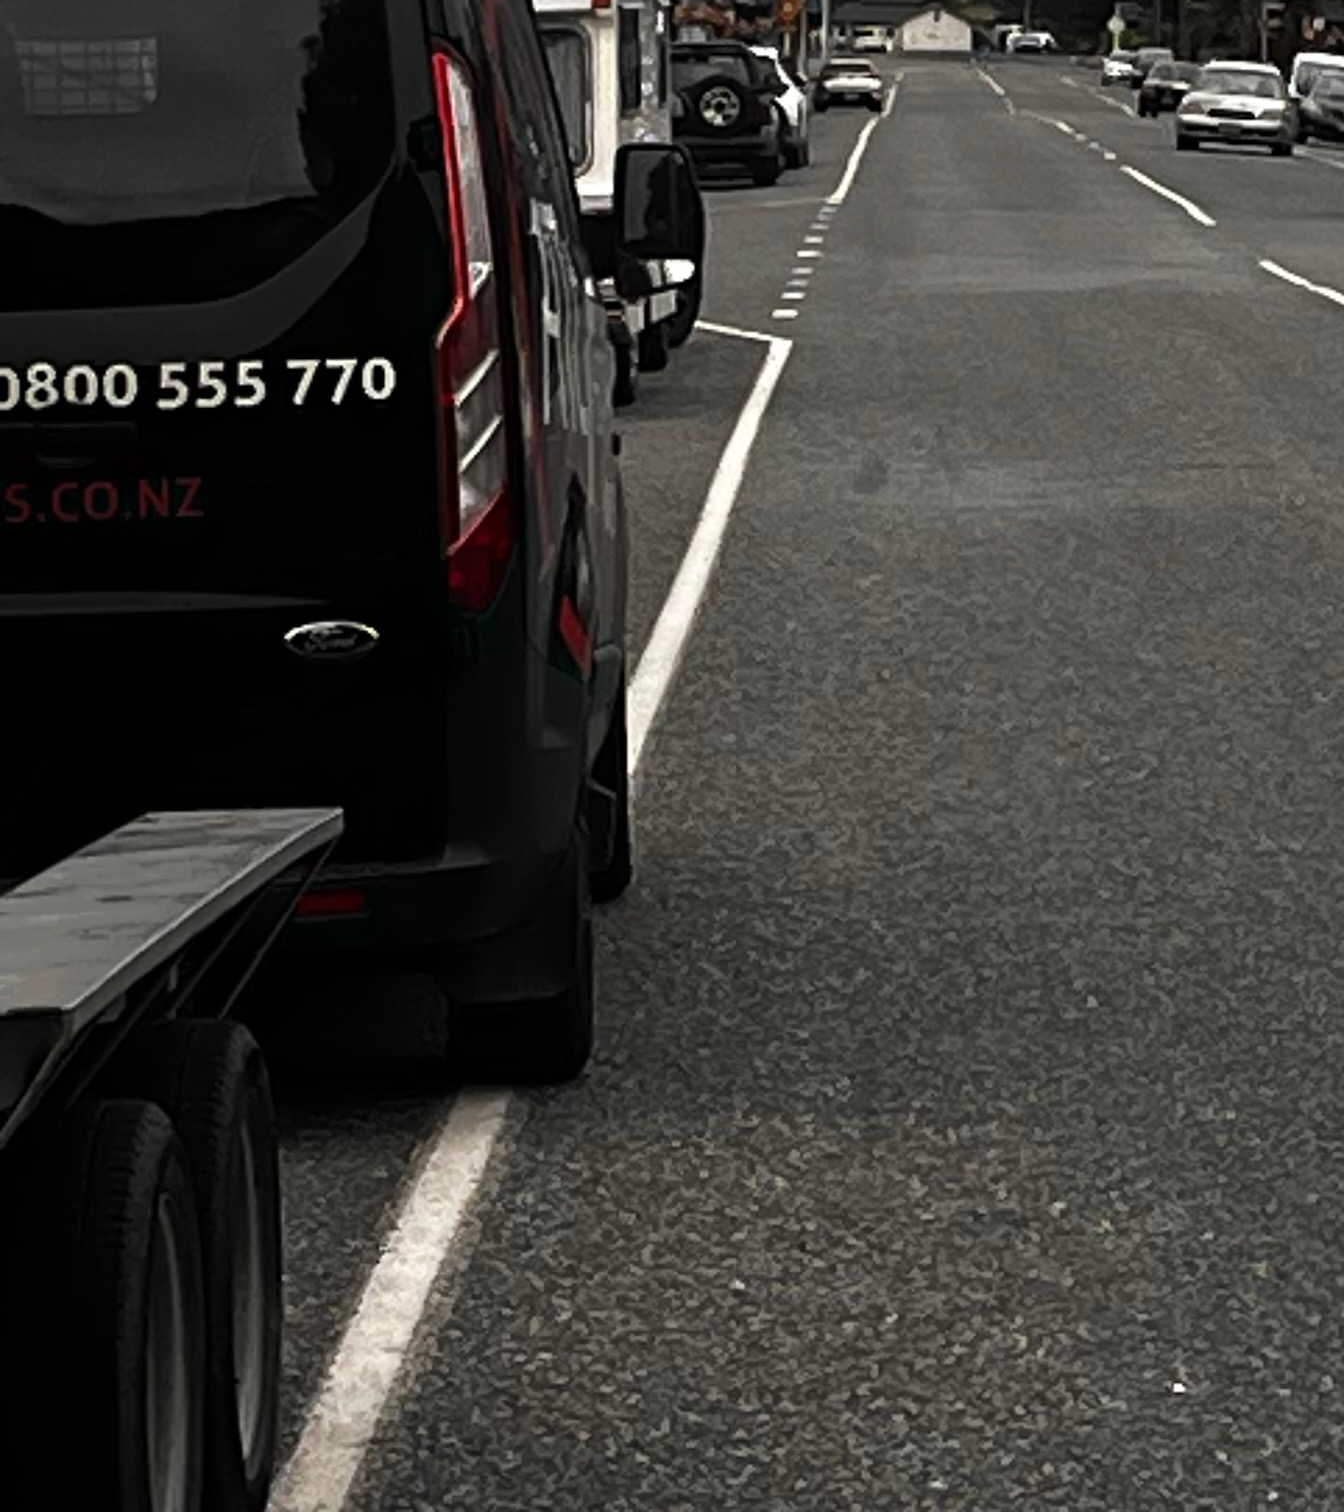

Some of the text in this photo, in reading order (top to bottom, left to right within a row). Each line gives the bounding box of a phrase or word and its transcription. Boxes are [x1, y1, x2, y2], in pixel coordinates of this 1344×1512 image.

[0, 356, 397, 411] 0800 555 770
